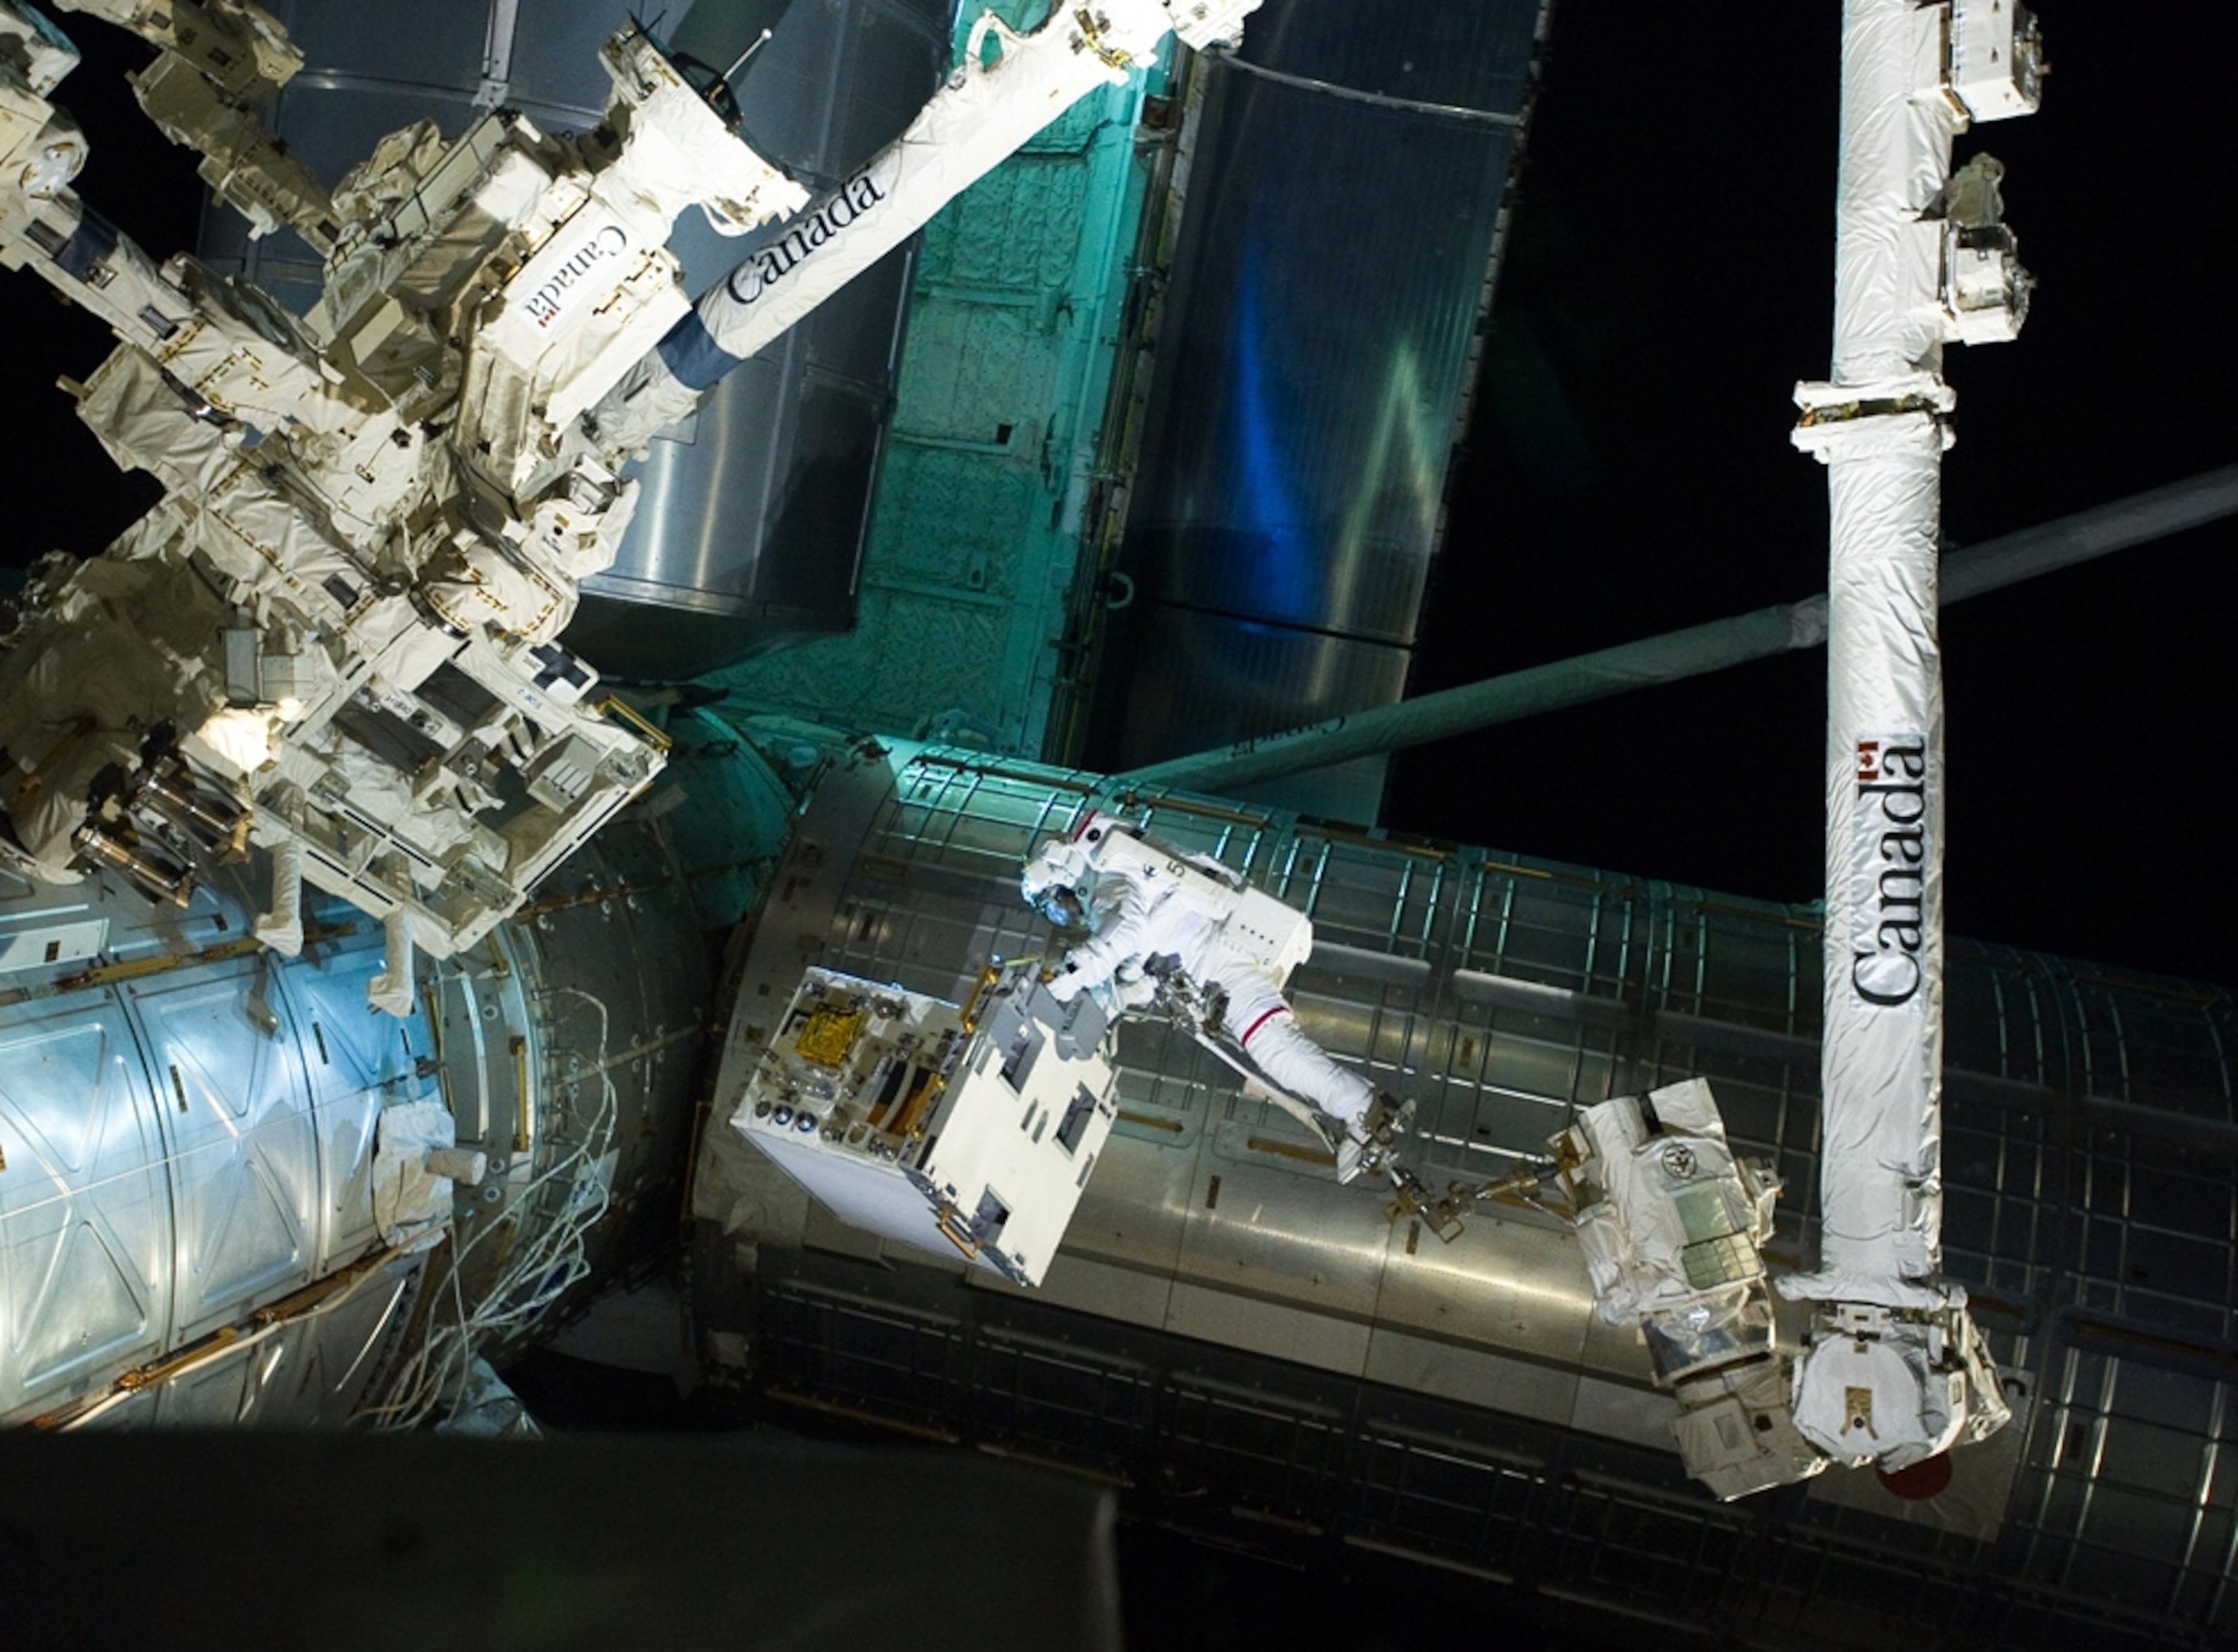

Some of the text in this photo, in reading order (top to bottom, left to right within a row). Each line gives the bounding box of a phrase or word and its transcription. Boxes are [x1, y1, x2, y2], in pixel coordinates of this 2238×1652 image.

[525, 225, 627, 318] Canada
[729, 176, 885, 304] Canada
[1852, 737, 1925, 1007] Canada
